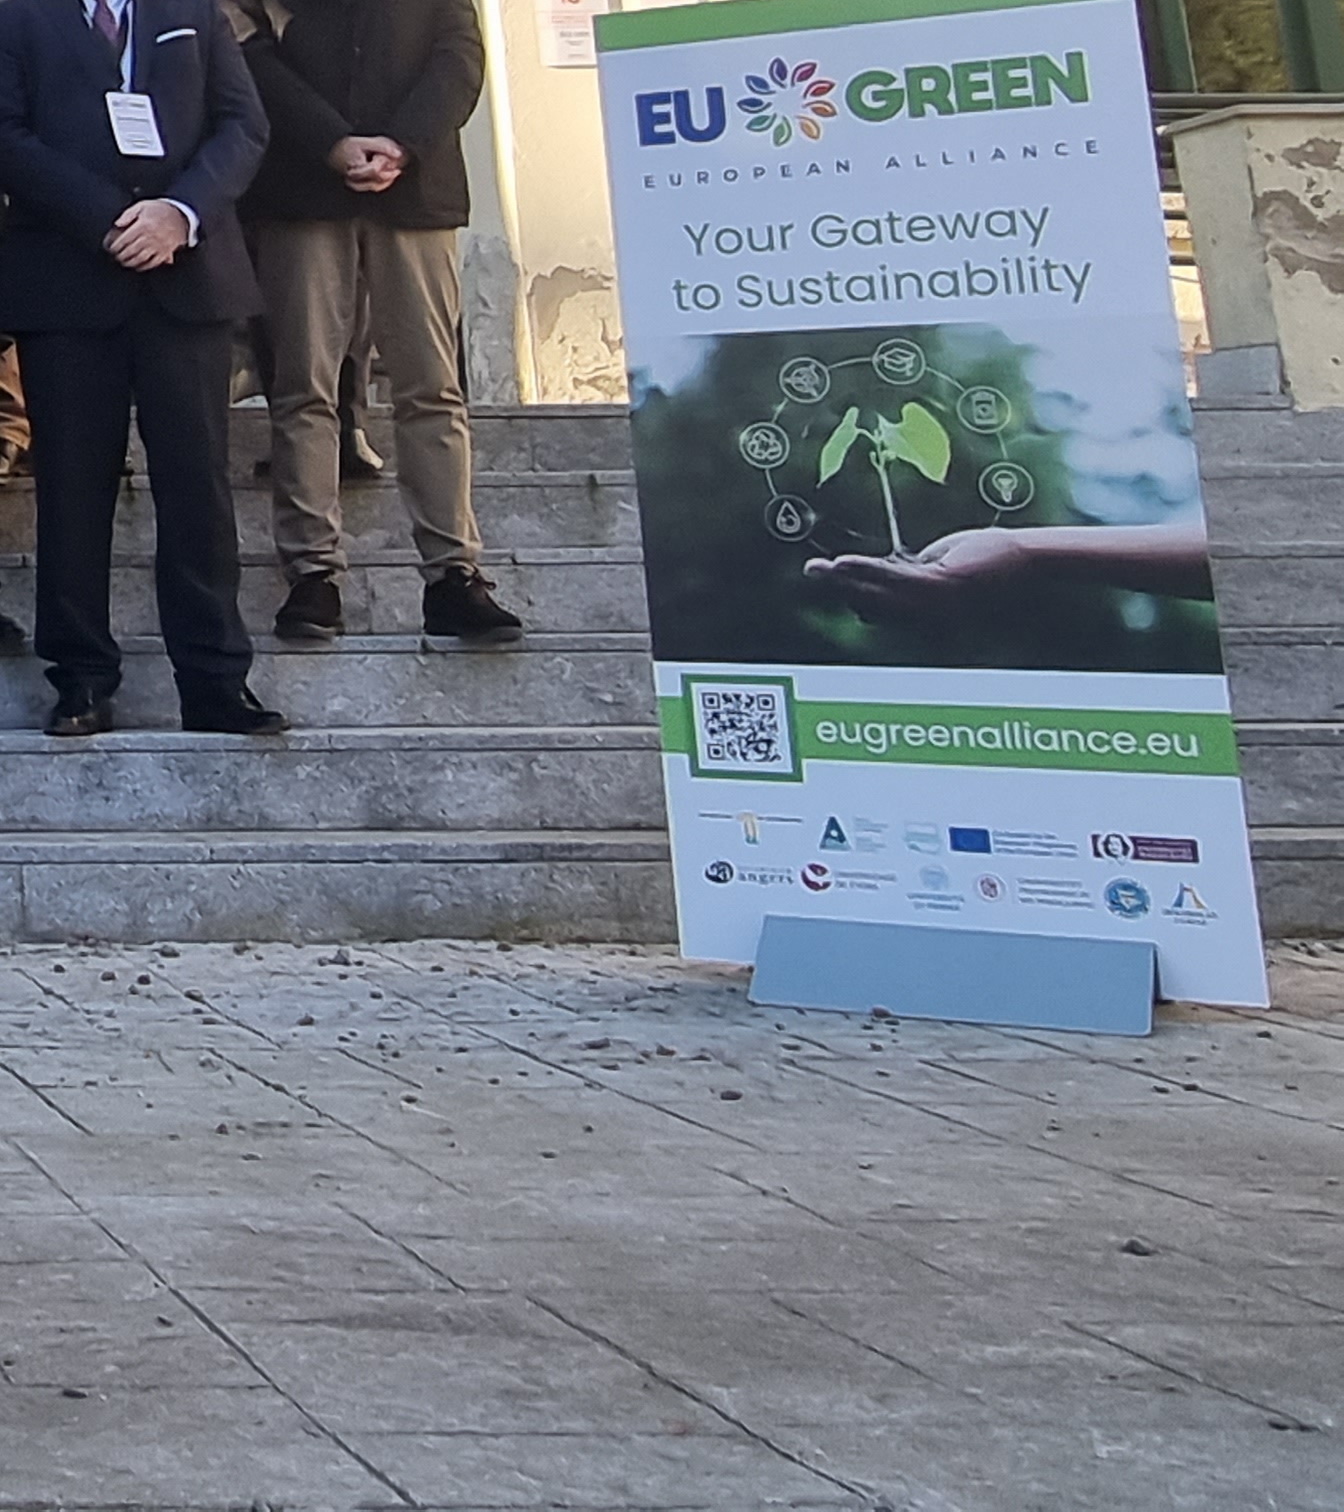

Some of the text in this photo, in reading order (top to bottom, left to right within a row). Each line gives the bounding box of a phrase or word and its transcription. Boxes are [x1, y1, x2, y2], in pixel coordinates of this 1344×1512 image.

[634, 51, 1090, 148] EU GREEN
[643, 139, 1100, 189] EUROPEAN ALLIANCE
[683, 205, 1051, 256] Your Gateway
[672, 256, 1093, 312] to Sustainability
[815, 718, 1201, 759] eugreenalliance.eu
